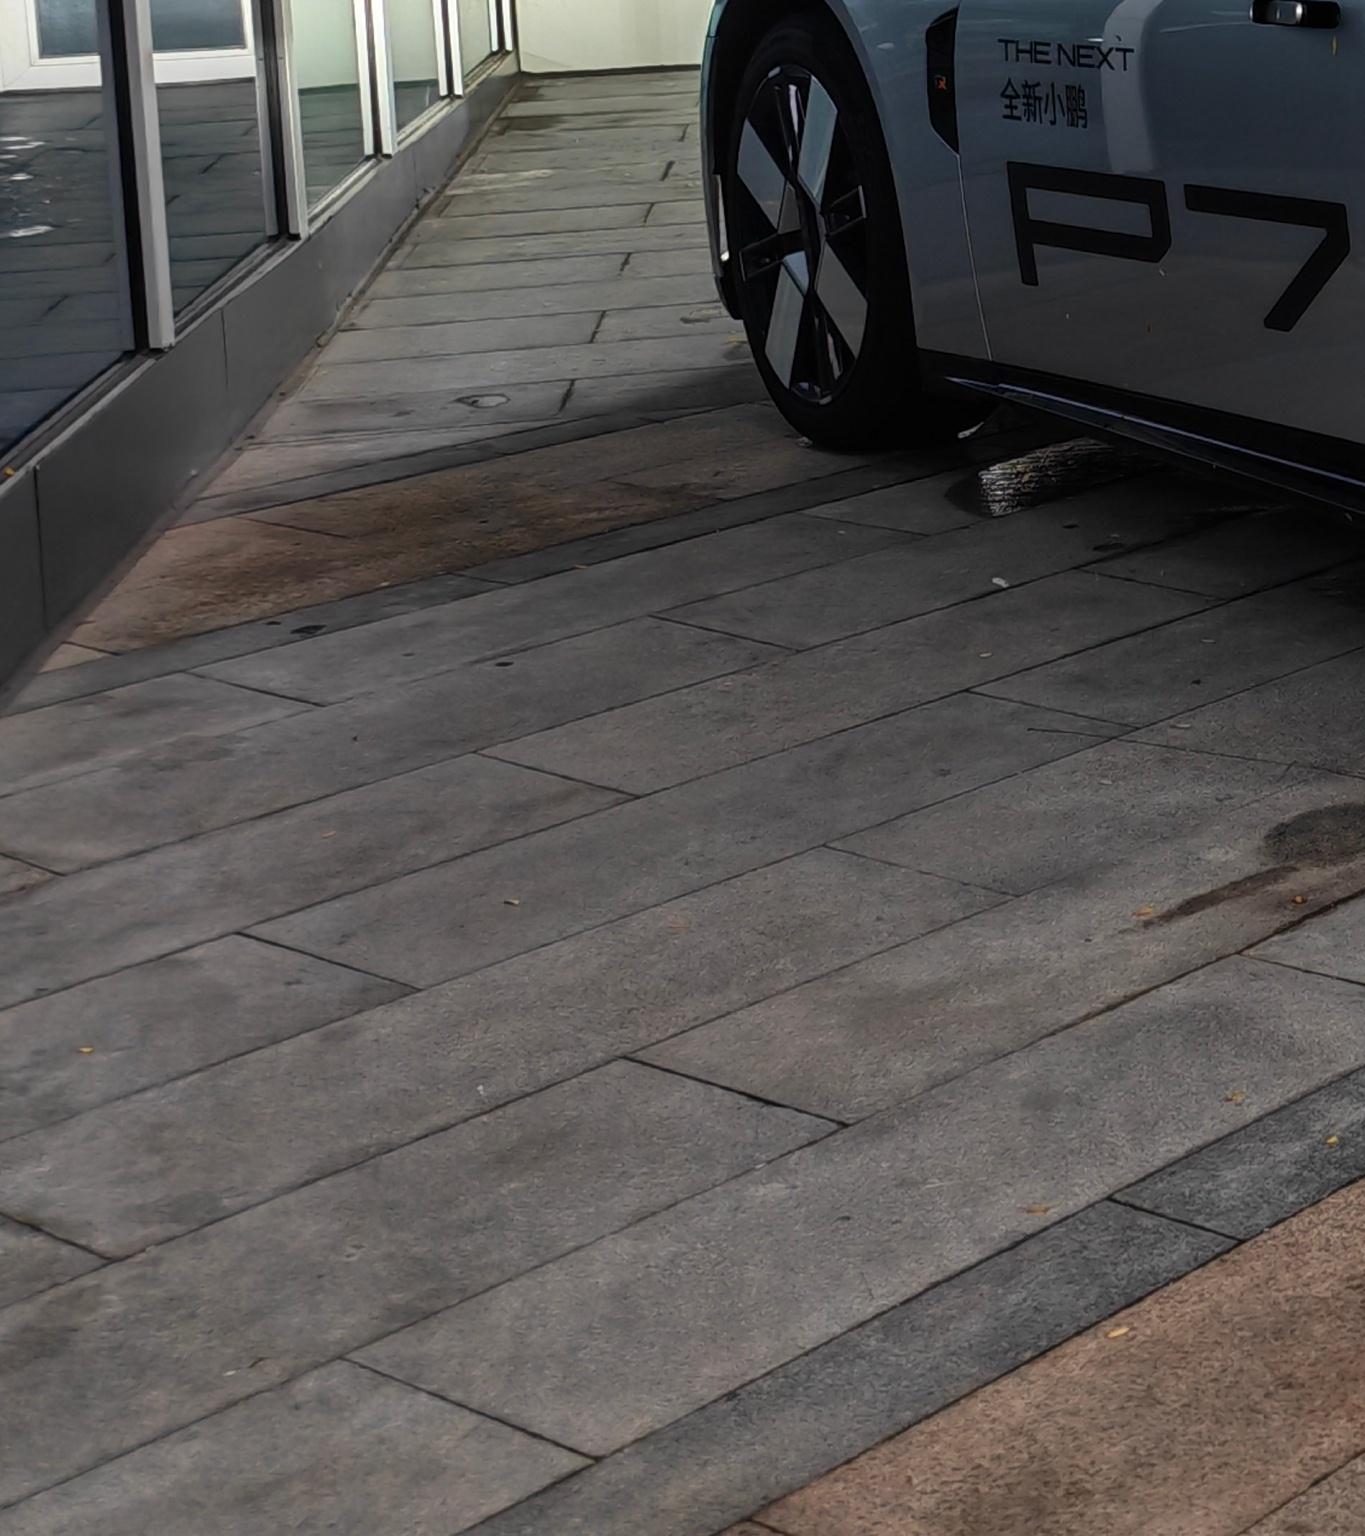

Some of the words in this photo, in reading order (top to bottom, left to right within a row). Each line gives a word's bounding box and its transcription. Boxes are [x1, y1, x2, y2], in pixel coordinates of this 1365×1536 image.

[997, 38, 1052, 65] THE
[1057, 42, 1135, 72] NEXT
[1000, 77, 1088, 129] 全新小鹏
[1006, 160, 1351, 333] P7
